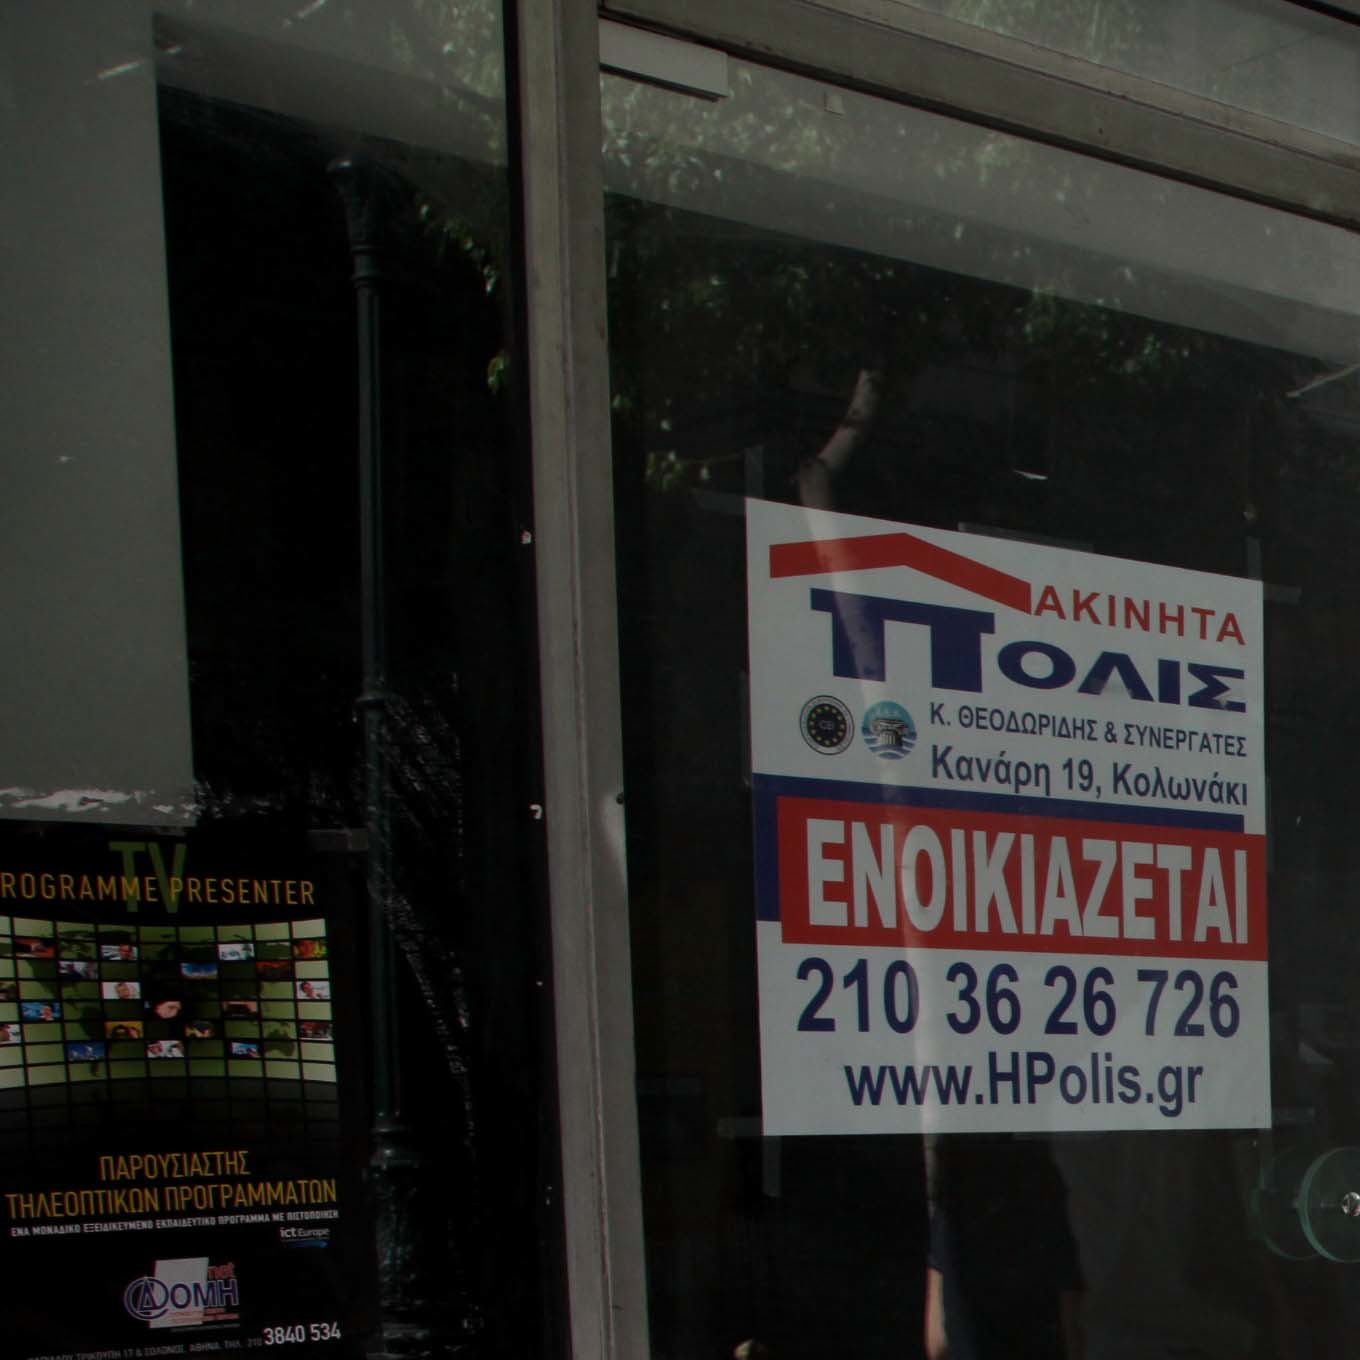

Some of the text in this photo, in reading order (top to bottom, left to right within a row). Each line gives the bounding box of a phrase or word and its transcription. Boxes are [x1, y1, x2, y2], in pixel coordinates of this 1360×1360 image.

[1034, 583, 1246, 646] ΑΚΙΝΗΤΑ
[810, 587, 1247, 713] ΠΟΛΙΣ
[929, 702, 1248, 758] Κ. ΘΕΟΔΩΡΙΔΗΣ & ΣΥΝΕΡΓΑΤΕΣ
[931, 745, 1248, 806] Κανάρη 19, Κολωνάκι
[0, 872, 316, 905] ROGRAMME PRESENTER
[108, 840, 189, 914] TV
[806, 818, 1249, 945] ΕΝΟΙΚΙΑΖΕΤΑΙ
[797, 957, 1241, 1038] 210 36 26 726
[844, 1052, 1204, 1118] www.HPolis.gr
[100, 1150, 250, 1182] ΠΑΡΟΥΣΙΑΣΤΗΣ
[4, 1178, 337, 1219] ΤΗΛΕΟΠΤΙΚΩΝ ΠΡΟΓΡΑΜΜΑΤΩΝ
[263, 1325, 306, 1346] 3840
[310, 1321, 341, 1341] 534
